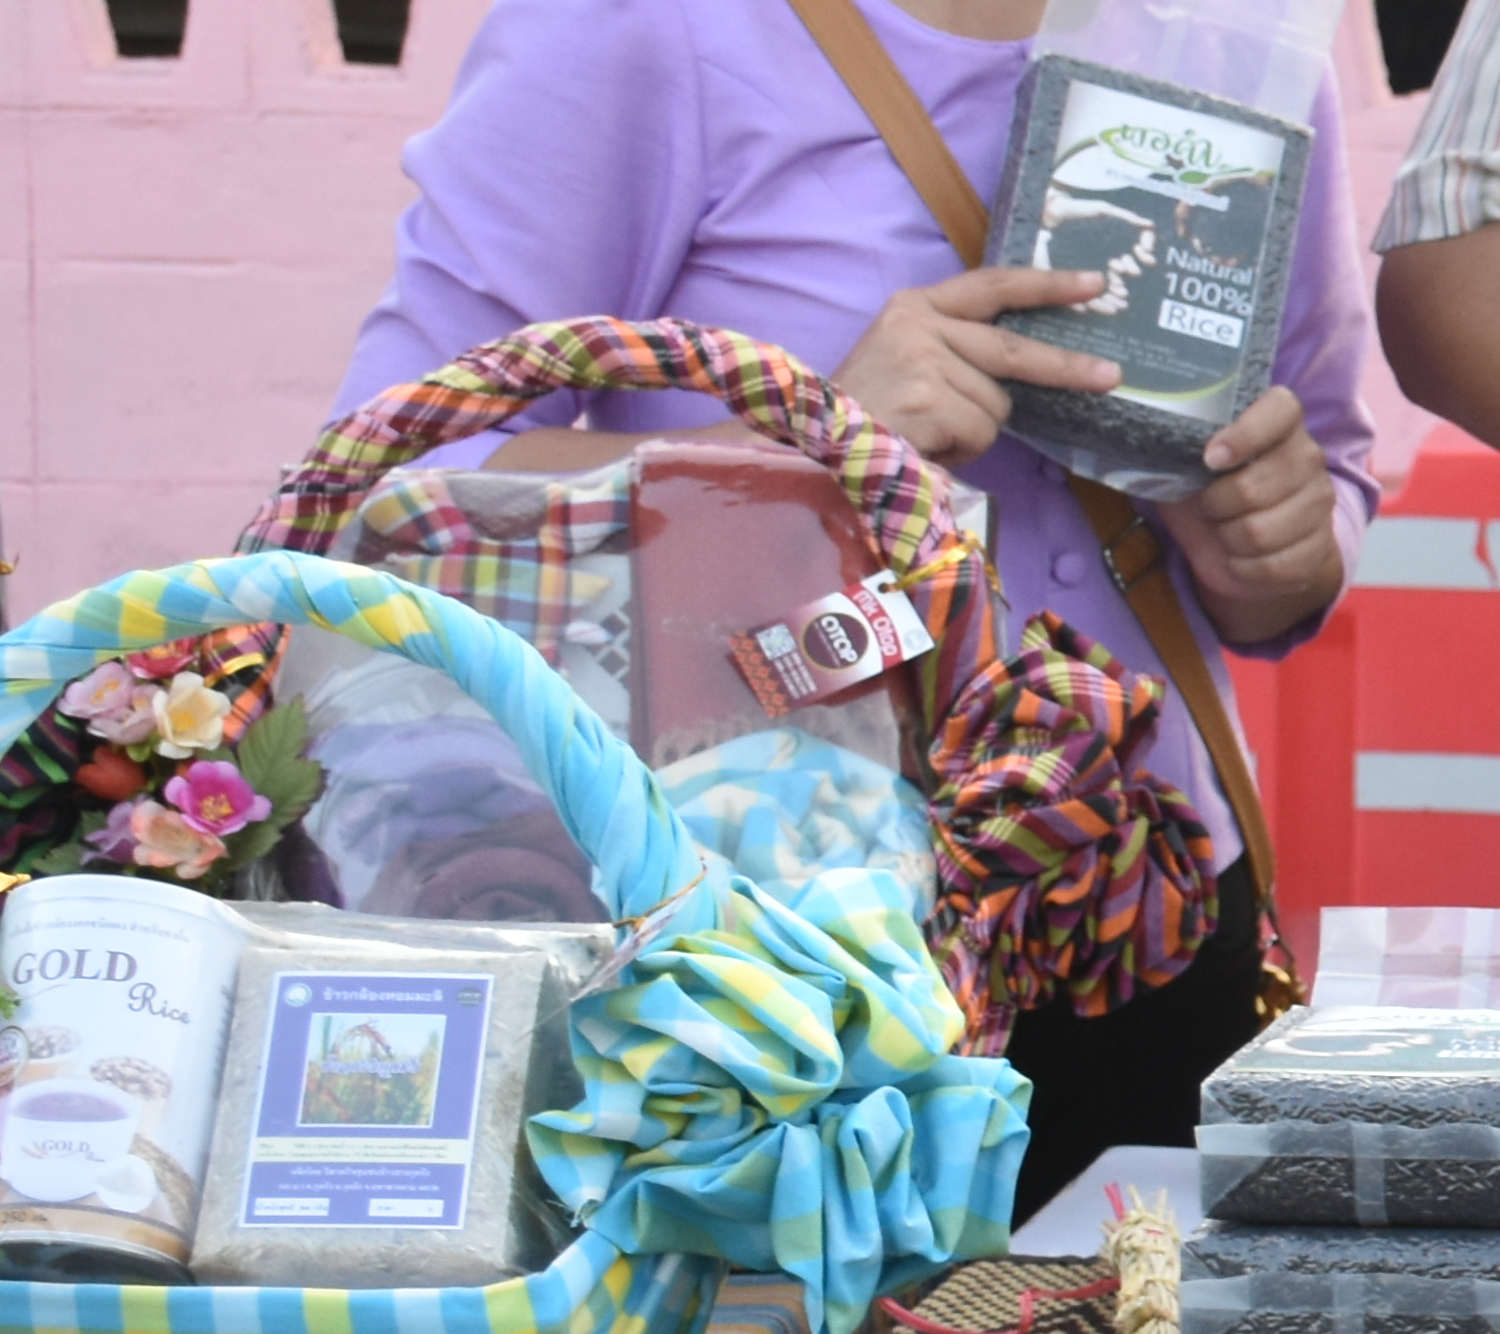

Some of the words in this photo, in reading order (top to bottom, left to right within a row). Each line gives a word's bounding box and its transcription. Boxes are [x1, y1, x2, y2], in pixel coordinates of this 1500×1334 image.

[1165, 245, 1254, 286] Natural
[1164, 269, 1254, 317] 100%
[1166, 299, 1235, 342] Rice
[820, 614, 859, 665] OTOP
[12, 947, 138, 986] GOLD
[127, 981, 191, 1025] Rice
[42, 1139, 91, 1153] GOLD
